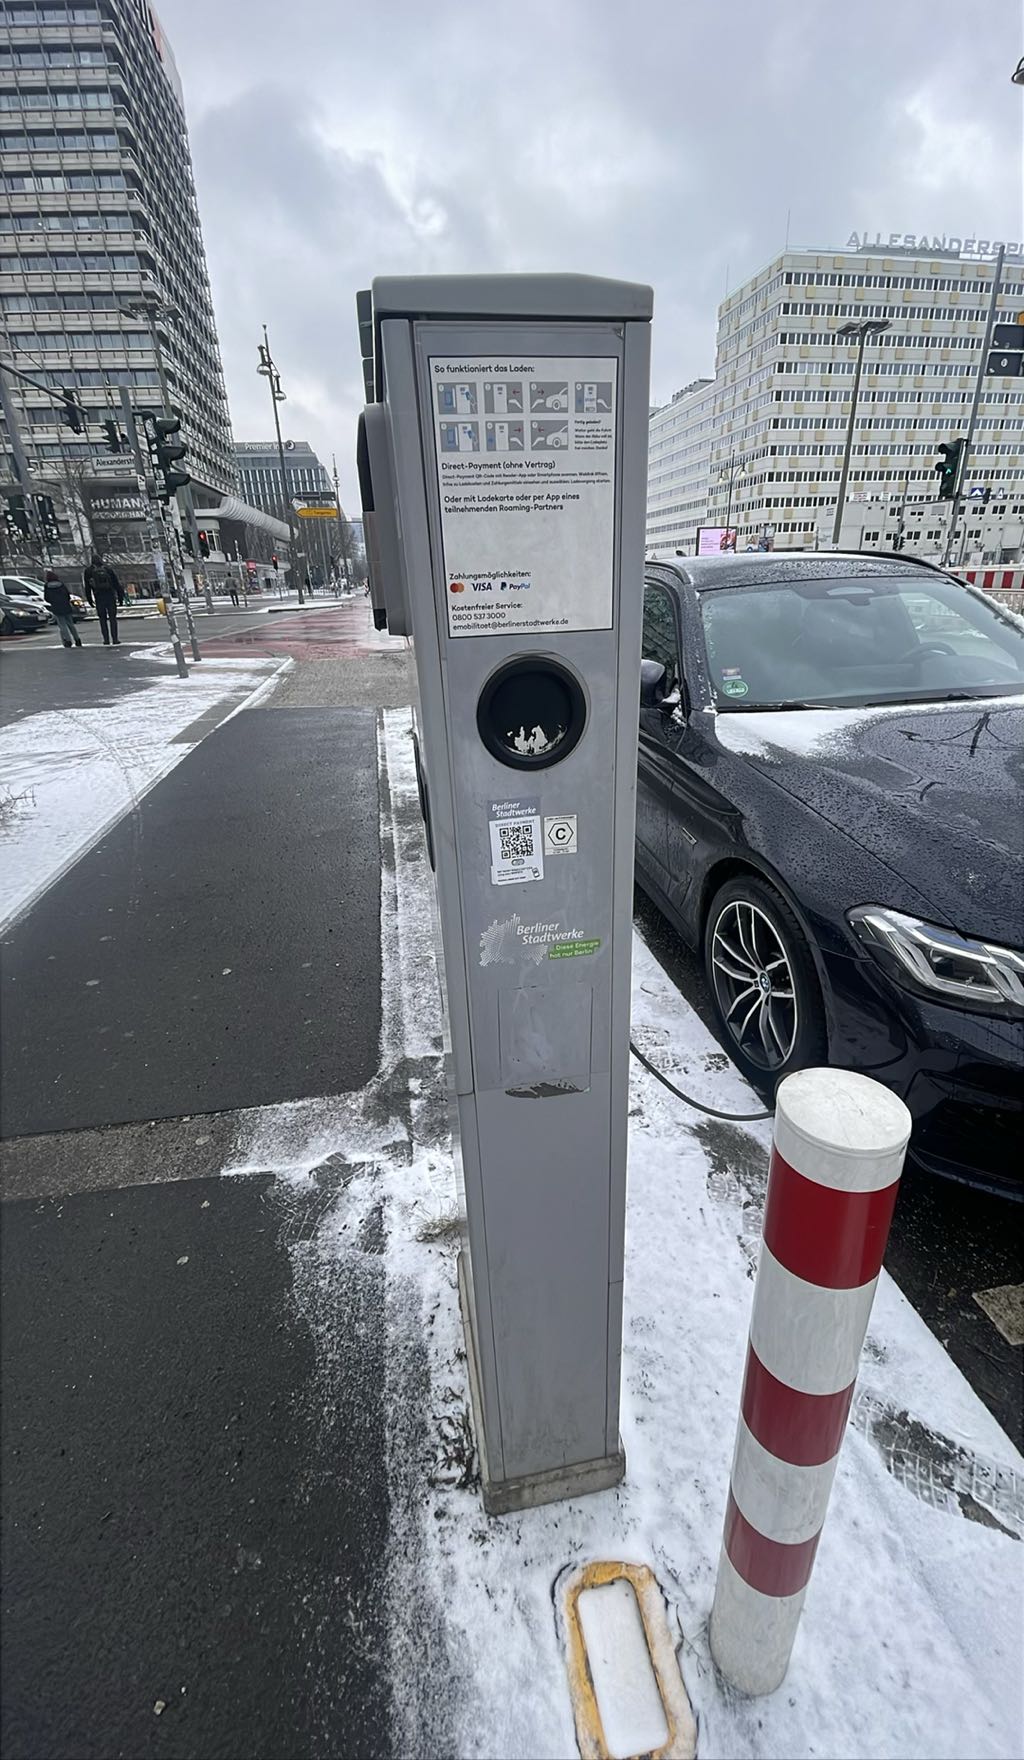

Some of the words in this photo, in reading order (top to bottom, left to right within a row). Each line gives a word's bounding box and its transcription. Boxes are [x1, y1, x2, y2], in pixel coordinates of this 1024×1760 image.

[434, 365, 445, 373] So
[446, 364, 493, 373] funktioniert
[494, 364, 508, 372] das
[509, 364, 535, 372] Laden:
[442, 462, 501, 471] Direct-Payment
[503, 461, 523, 469] (ohne
[524, 461, 556, 469] Vertrag)
[444, 495, 461, 503] Oder
[463, 495, 476, 503] mit
[477, 494, 514, 503] Ladekarte
[533, 494, 544, 502] per
[546, 493, 560, 502] App
[91, 498, 144, 509] HUMAN
[444, 505, 498, 513] teilnehmenden
[499, 504, 564, 512] Roaming-Partners
[449, 571, 531, 580] Zahlungsmöglichkeiten:
[471, 582, 492, 591] VISA
[452, 603, 494, 612] Kostenfreier
[496, 602, 523, 610] Service:
[492, 802, 520, 811] Berliner
[496, 807, 536, 817] Stadtwerke
[555, 827, 566, 840] C
[516, 923, 560, 935] Berliner
[522, 928, 585, 945] Stadtwerke
